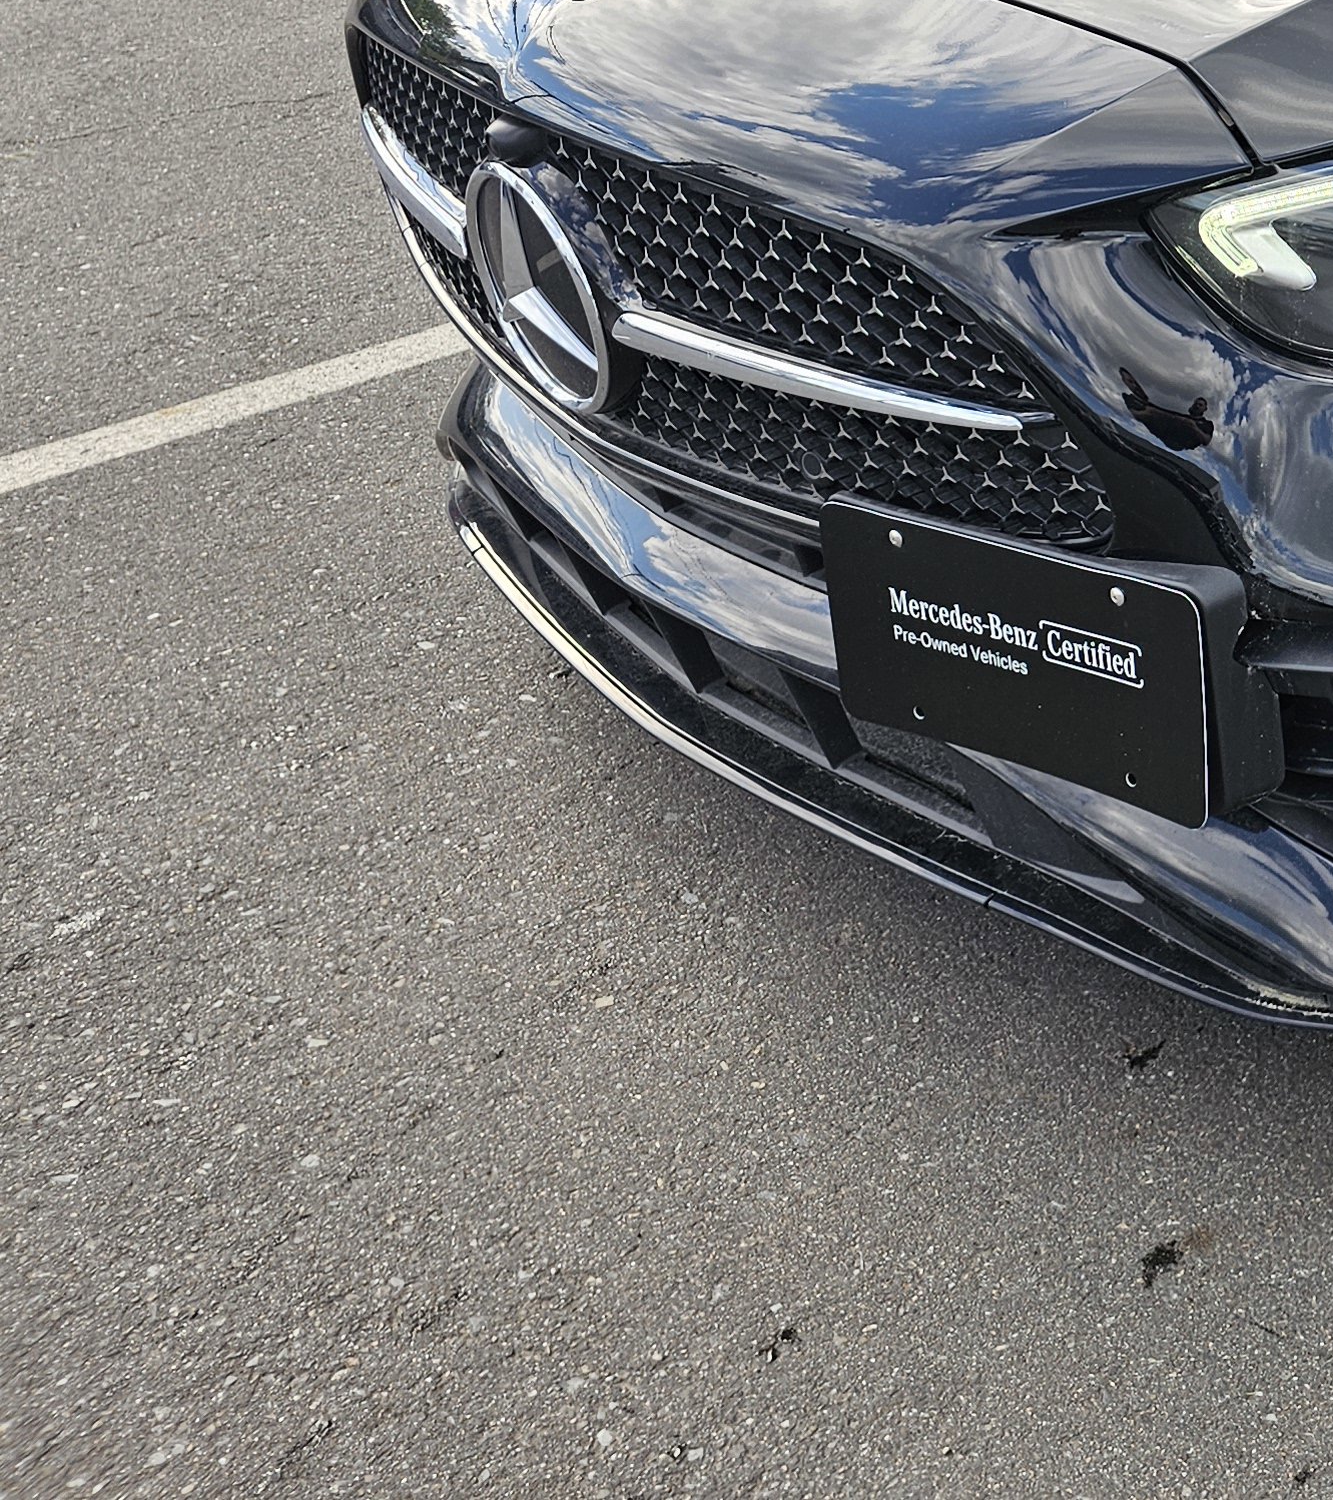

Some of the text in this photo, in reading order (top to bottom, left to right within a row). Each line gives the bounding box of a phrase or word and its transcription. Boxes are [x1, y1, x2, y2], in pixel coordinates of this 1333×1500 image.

[888, 587, 1138, 680] Mercedes-Benz Certified
[893, 624, 1029, 676] Pre-Owned Vehicles
